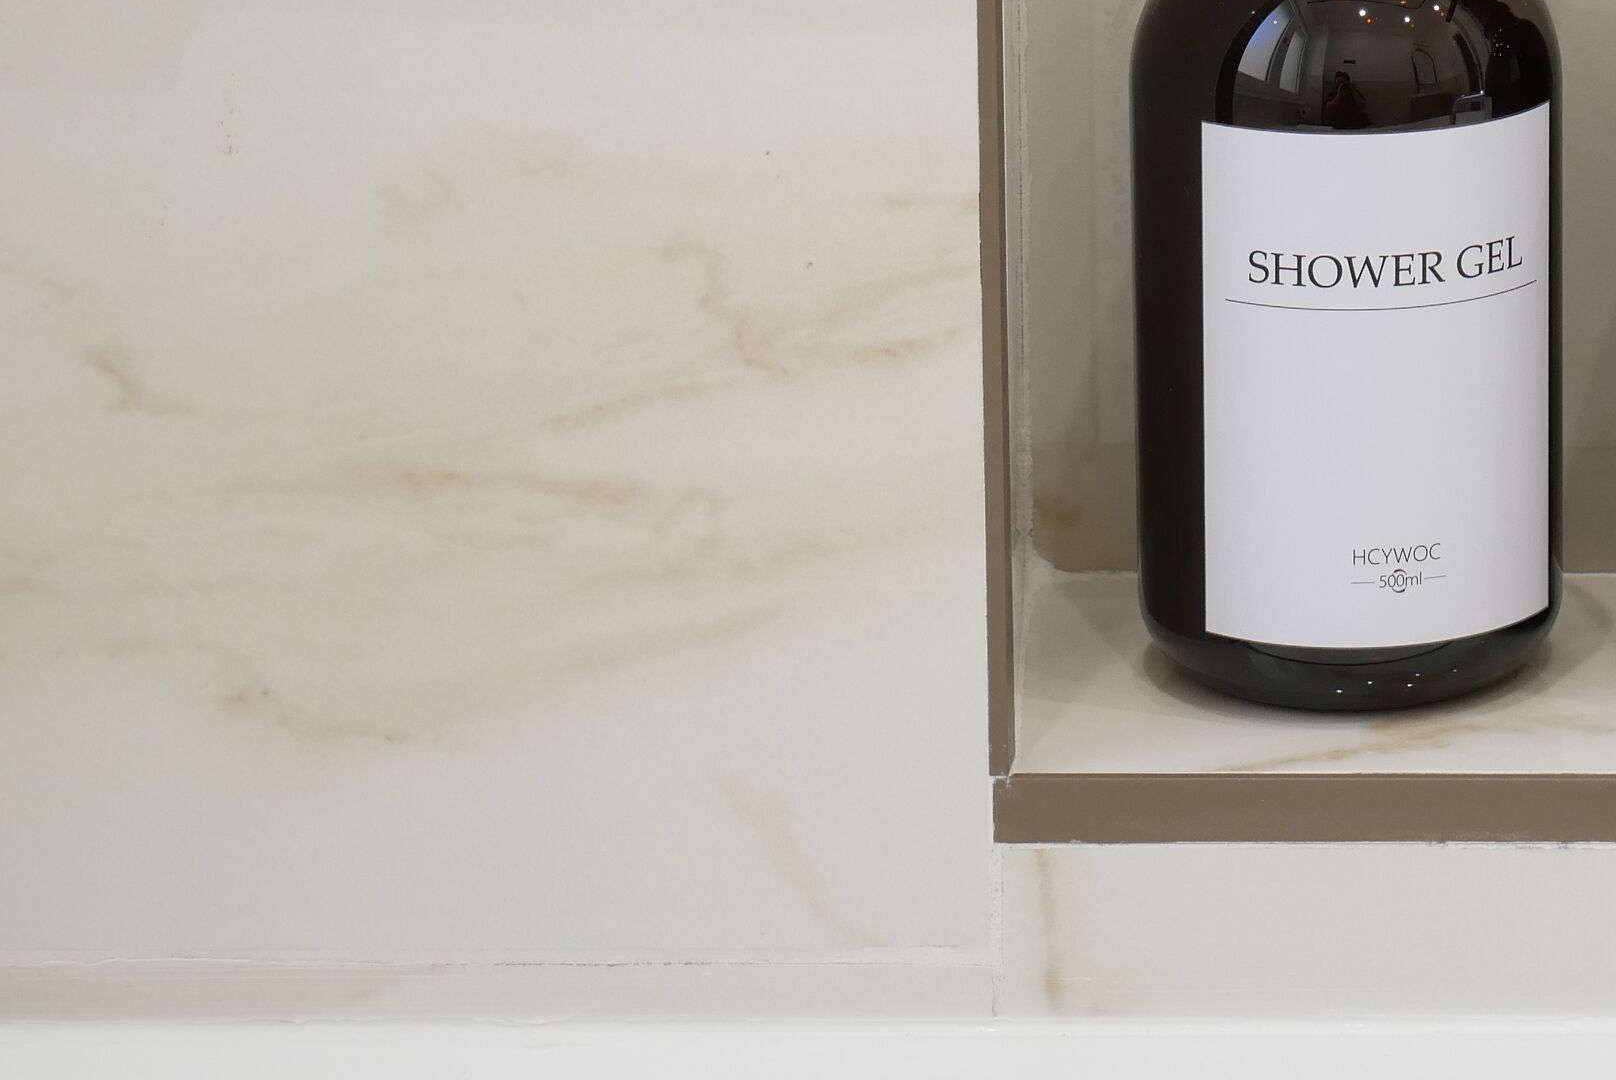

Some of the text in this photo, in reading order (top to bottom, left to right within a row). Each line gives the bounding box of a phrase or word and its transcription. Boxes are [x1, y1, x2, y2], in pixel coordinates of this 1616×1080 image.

[1248, 235, 1523, 289] SHOWER GEL
[1352, 542, 1441, 566] HCYWOC
[1378, 570, 1423, 589] 500ml
